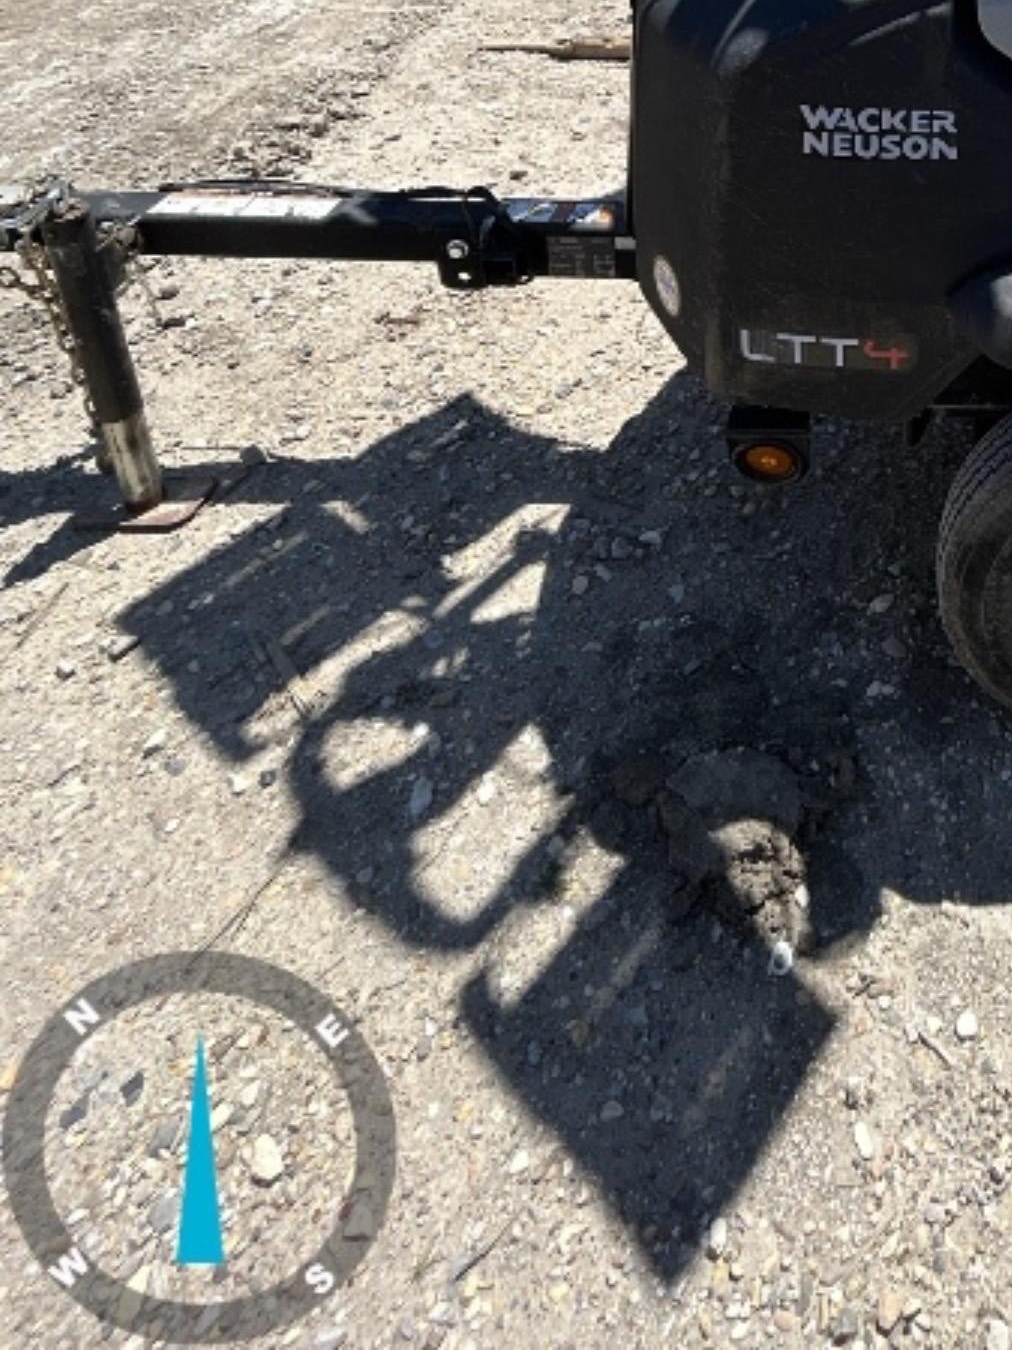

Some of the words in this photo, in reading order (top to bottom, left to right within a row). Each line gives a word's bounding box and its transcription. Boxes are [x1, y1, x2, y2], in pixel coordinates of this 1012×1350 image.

[799, 104, 958, 134] WACKER
[802, 131, 959, 161] NEUSON
[738, 328, 910, 370] LTT4
